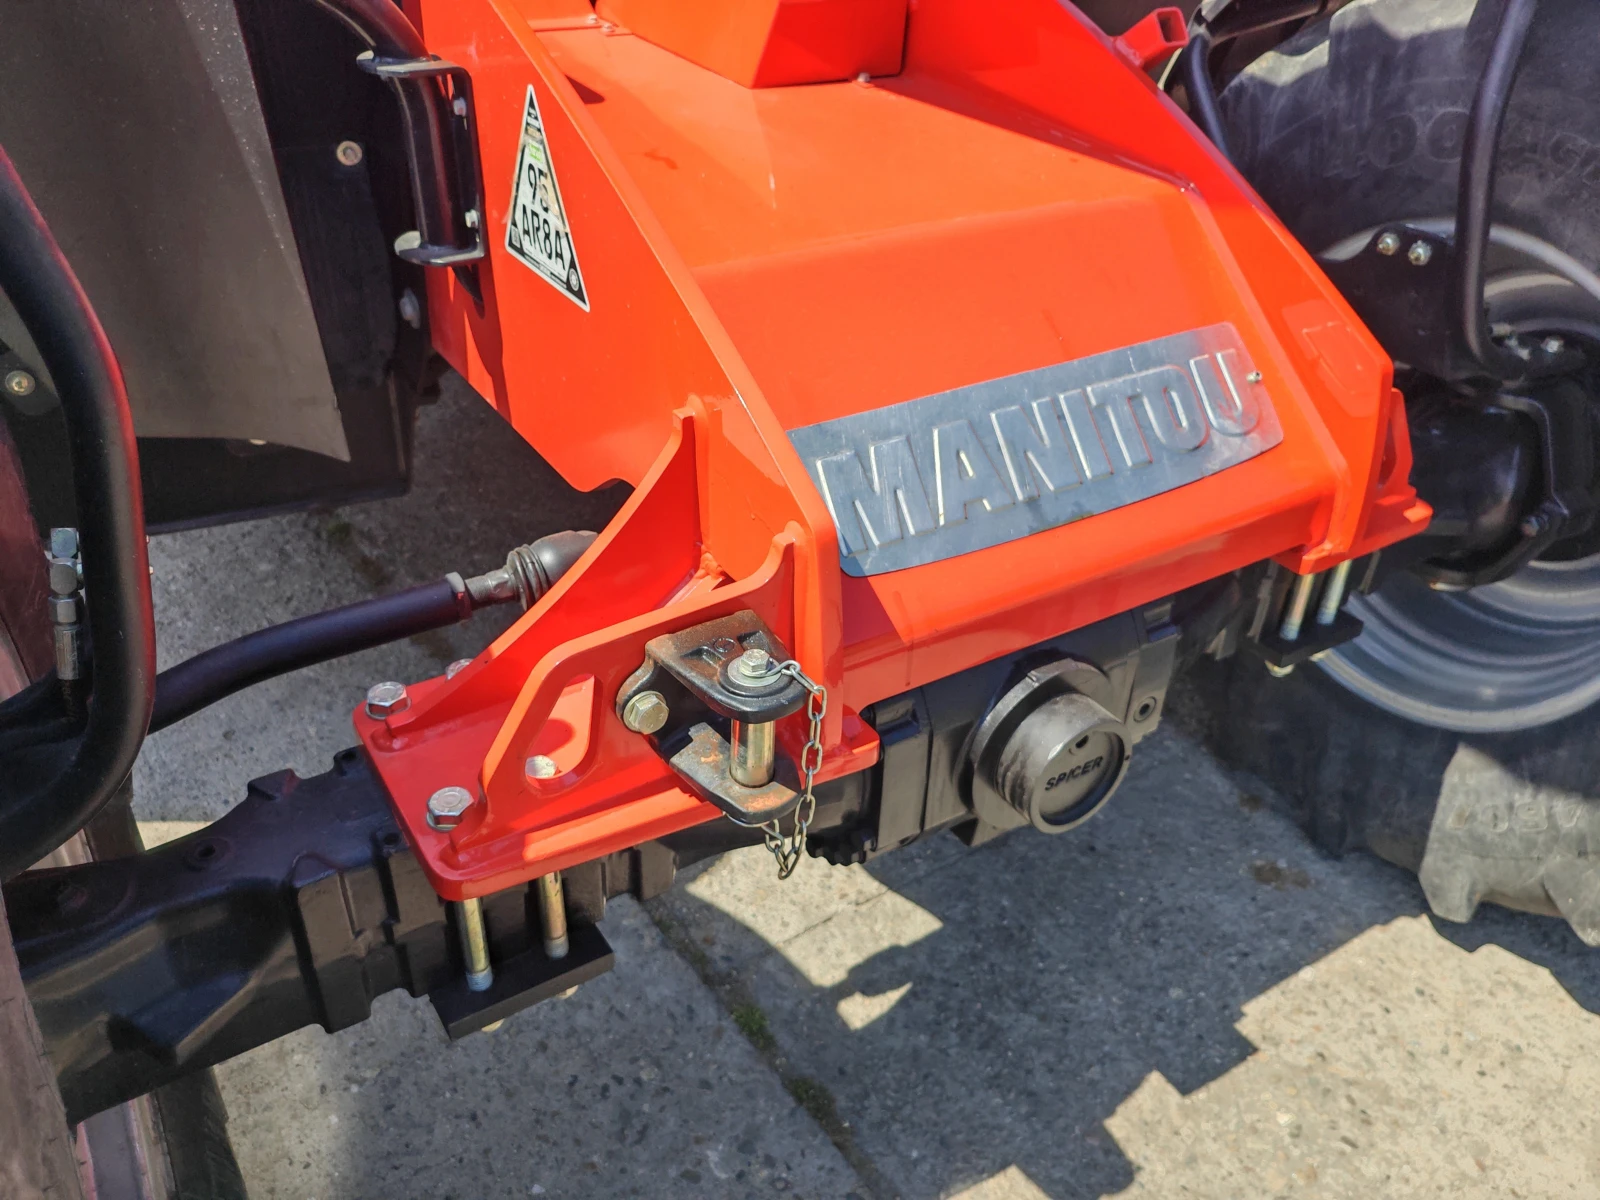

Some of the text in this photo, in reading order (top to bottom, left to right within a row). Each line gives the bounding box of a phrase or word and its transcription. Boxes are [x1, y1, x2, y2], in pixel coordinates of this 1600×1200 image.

[523, 203, 567, 271] AR8A
[816, 348, 1261, 557] MANITOU
[1044, 755, 1103, 791] SPICER
